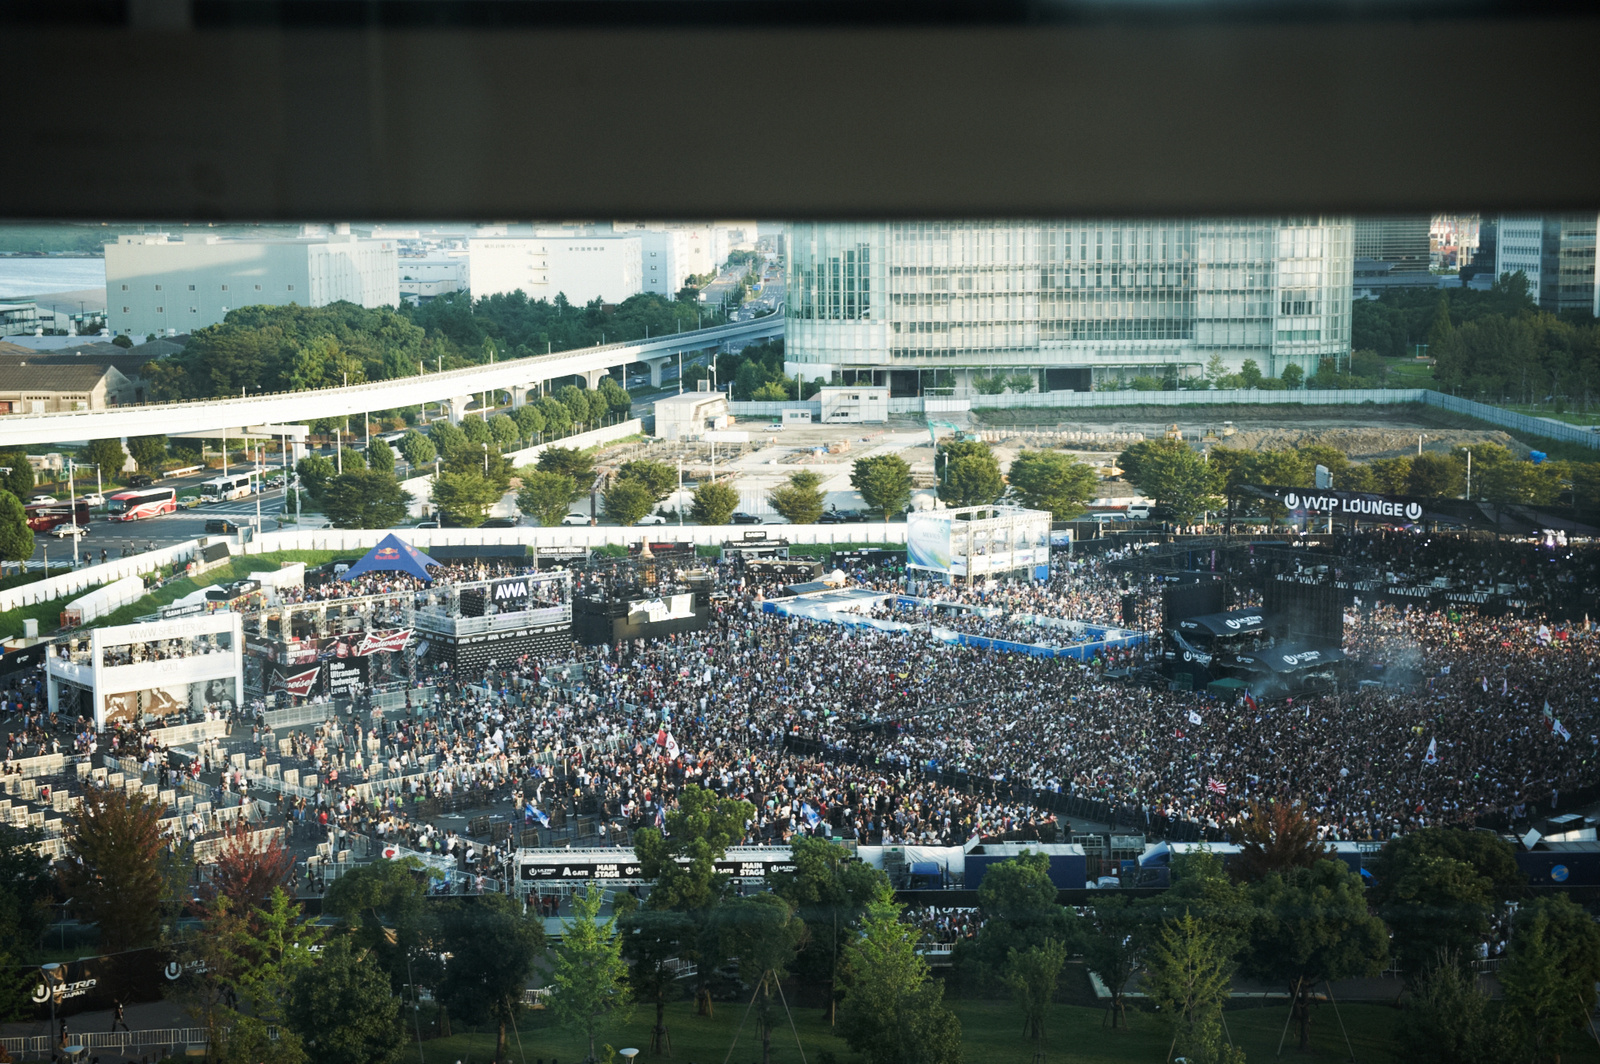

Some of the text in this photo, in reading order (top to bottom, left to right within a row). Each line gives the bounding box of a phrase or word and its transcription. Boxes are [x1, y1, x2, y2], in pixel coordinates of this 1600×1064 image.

[1302, 496, 1405, 517] VVIP LOUNGE
[495, 582, 528, 600] AWA
[357, 636, 416, 651] Budweiser
[330, 662, 345, 671] Hello
[330, 668, 360, 678] Ultranauts
[331, 686, 347, 695] Loves
[562, 866, 571, 876] A
[739, 868, 765, 877] STAGE
[52, 979, 97, 993] ULTRA
[62, 989, 87, 999] JAPAN
